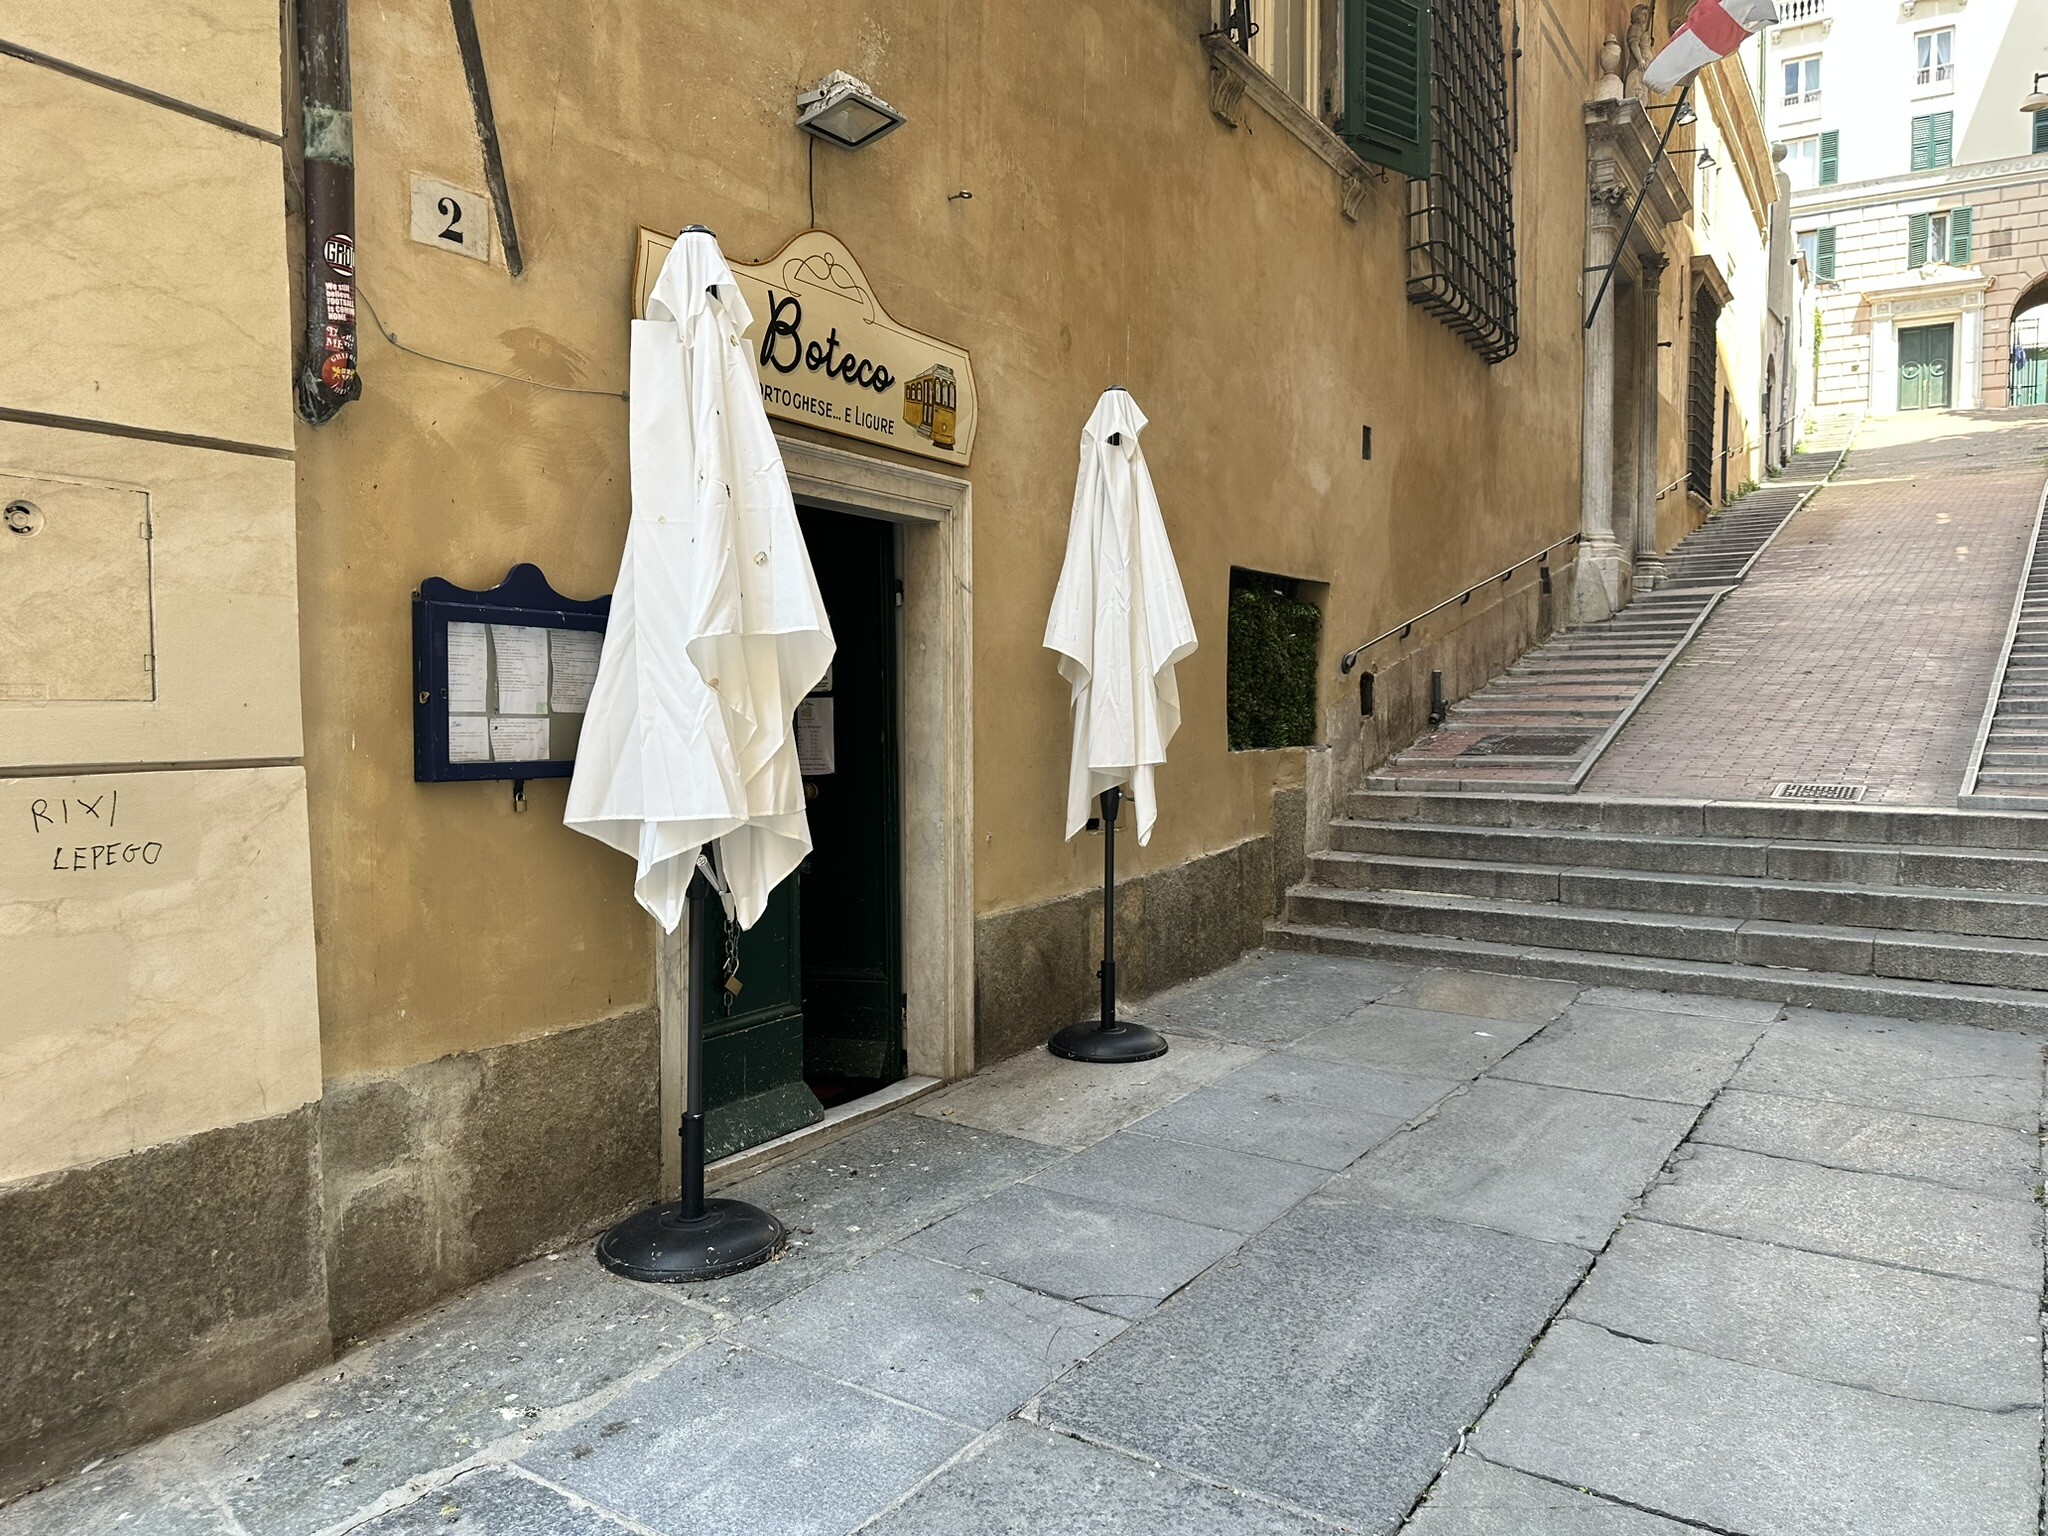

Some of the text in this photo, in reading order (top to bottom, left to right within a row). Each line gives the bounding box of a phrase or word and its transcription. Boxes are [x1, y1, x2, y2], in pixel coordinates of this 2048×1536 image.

[437, 197, 464, 244] 2
[760, 290, 895, 392] Boteco
[845, 407, 852, 423] E
